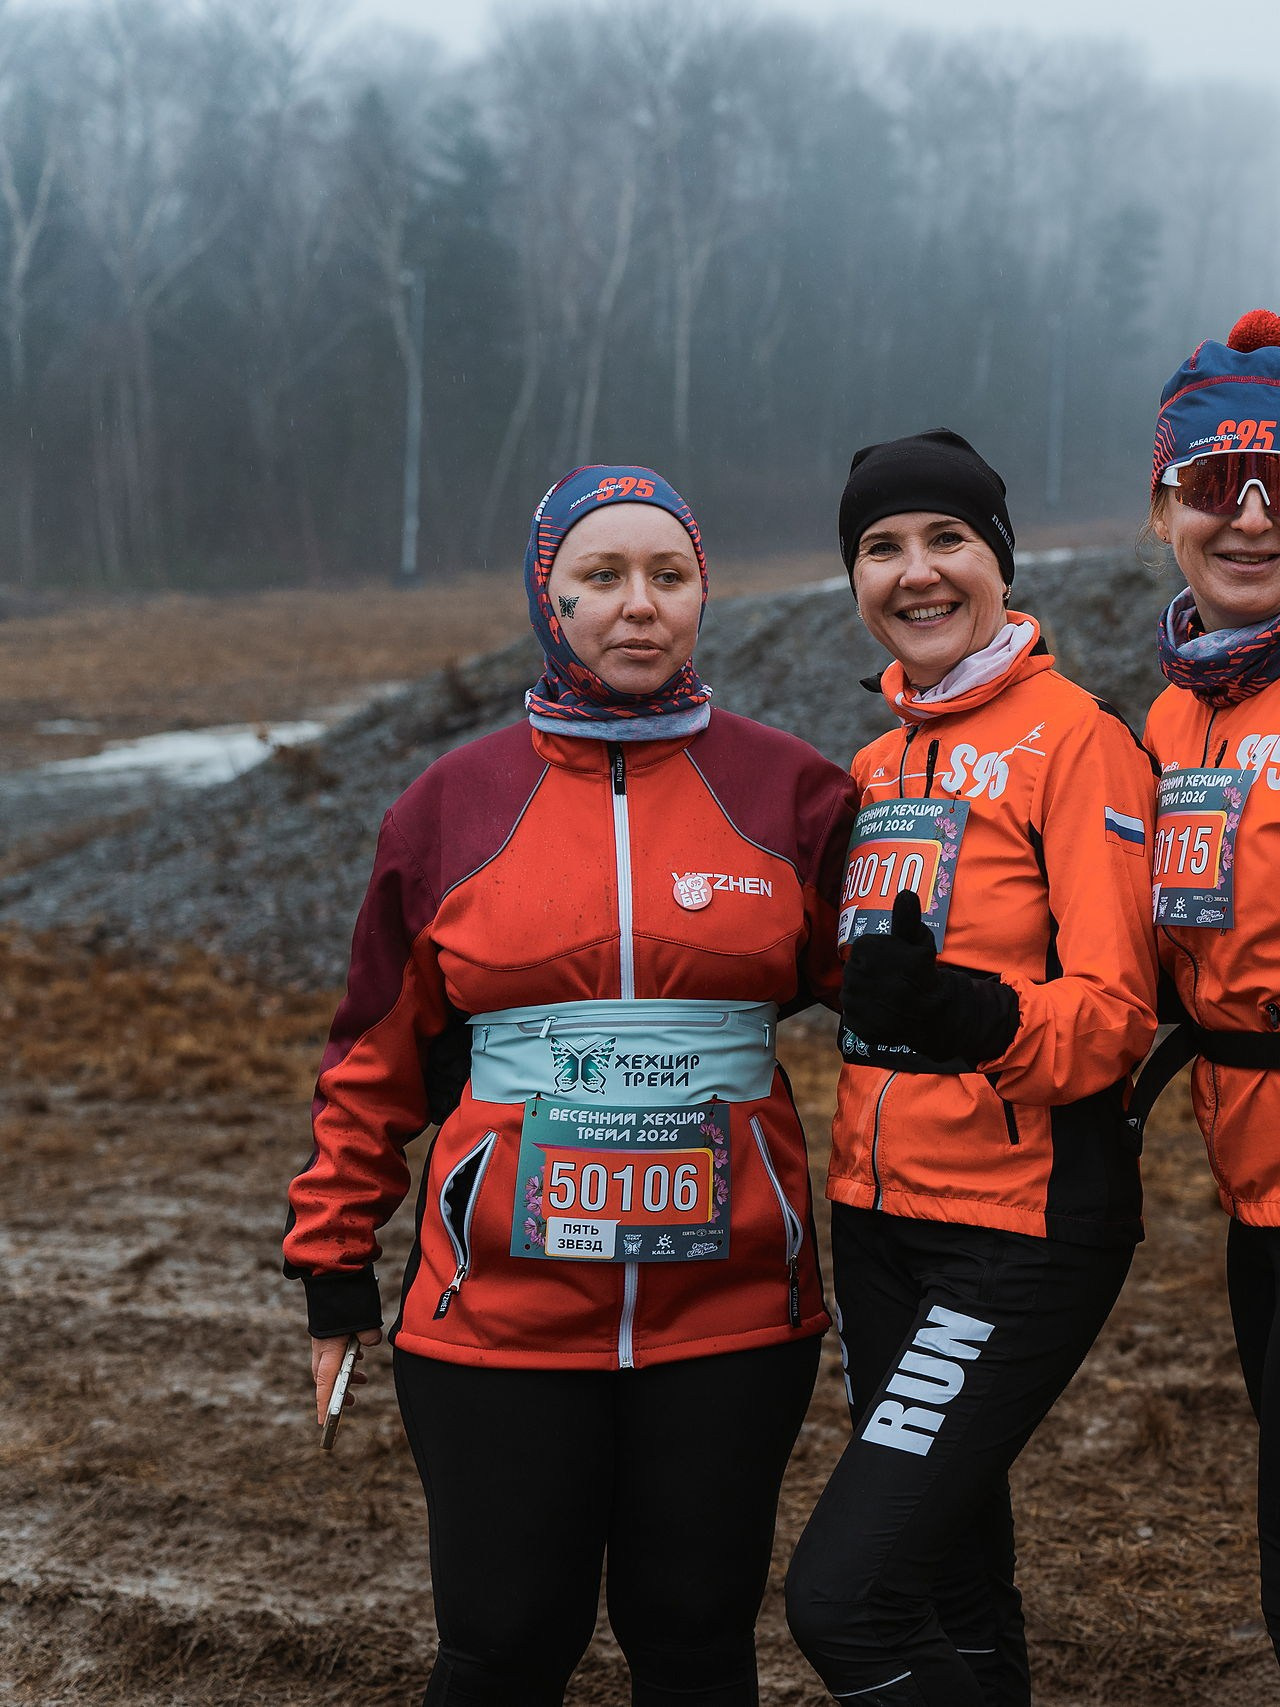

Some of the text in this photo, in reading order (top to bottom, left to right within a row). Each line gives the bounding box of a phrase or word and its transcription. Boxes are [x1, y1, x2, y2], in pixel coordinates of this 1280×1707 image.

[1211, 419, 1278, 451] S95
[596, 476, 656, 501] S95
[940, 743, 1010, 800] S95
[1184, 774, 1233, 788] ХЕХЦИР
[1180, 790, 1208, 804] 2026
[890, 804, 944, 817] ХЕХЦИР
[884, 819, 916, 832] 2026
[681, 888, 708, 908] БЕГ
[614, 1053, 701, 1071] ХЕХЦИР
[622, 1071, 690, 1088] ТРЕЙЛ
[549, 1108, 706, 1126] ВЕСЕННИЙ ХЕХЦИР
[576, 1126, 680, 1142] ТРЕЙЛ 2026
[549, 1161, 699, 1213] 50106
[562, 1222, 600, 1236] ПЯТЬ
[557, 1239, 603, 1253] ЗВЕЗД
[860, 1304, 996, 1457] RUN
